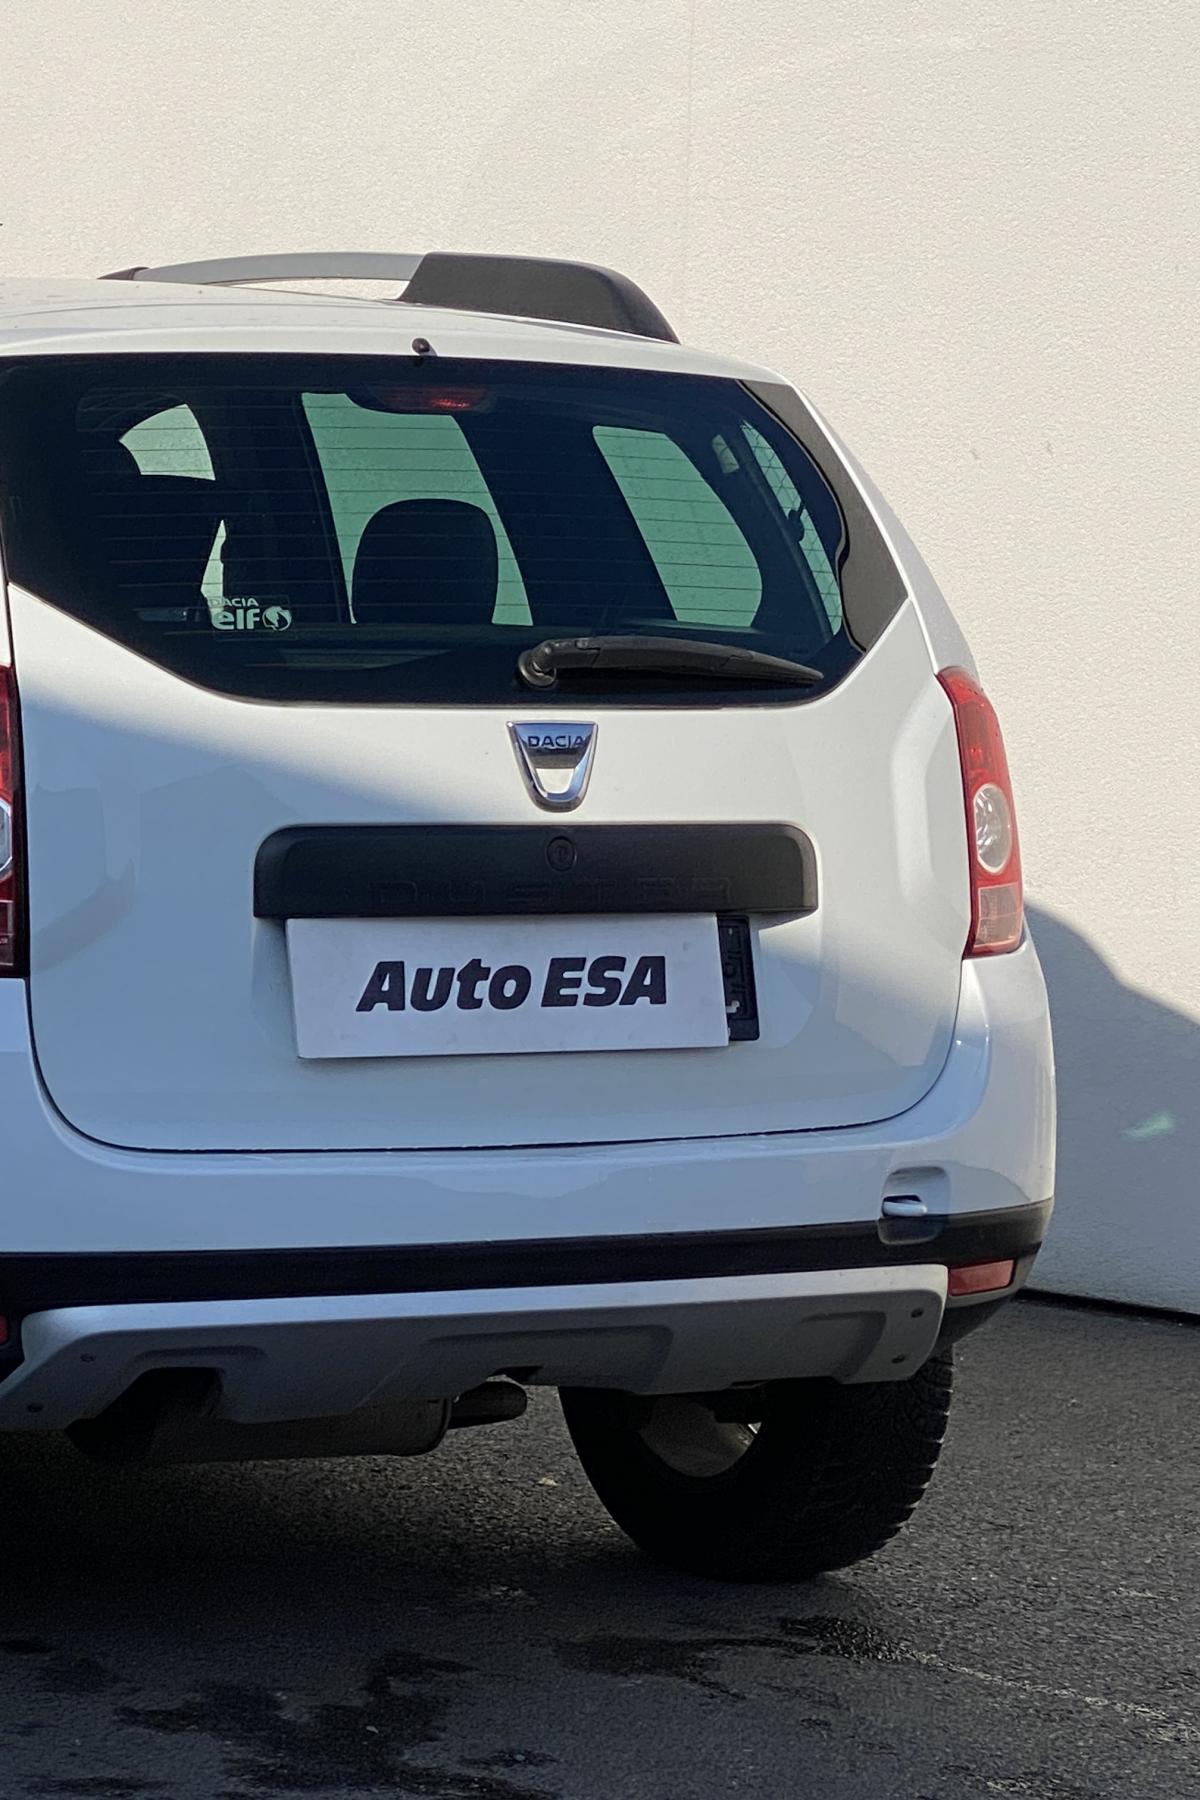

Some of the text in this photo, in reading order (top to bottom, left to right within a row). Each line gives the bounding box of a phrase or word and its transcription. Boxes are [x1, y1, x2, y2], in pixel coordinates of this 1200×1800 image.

[211, 608, 260, 630] elf
[527, 735, 585, 748] DACIA
[355, 955, 667, 1012] Auto ESA
